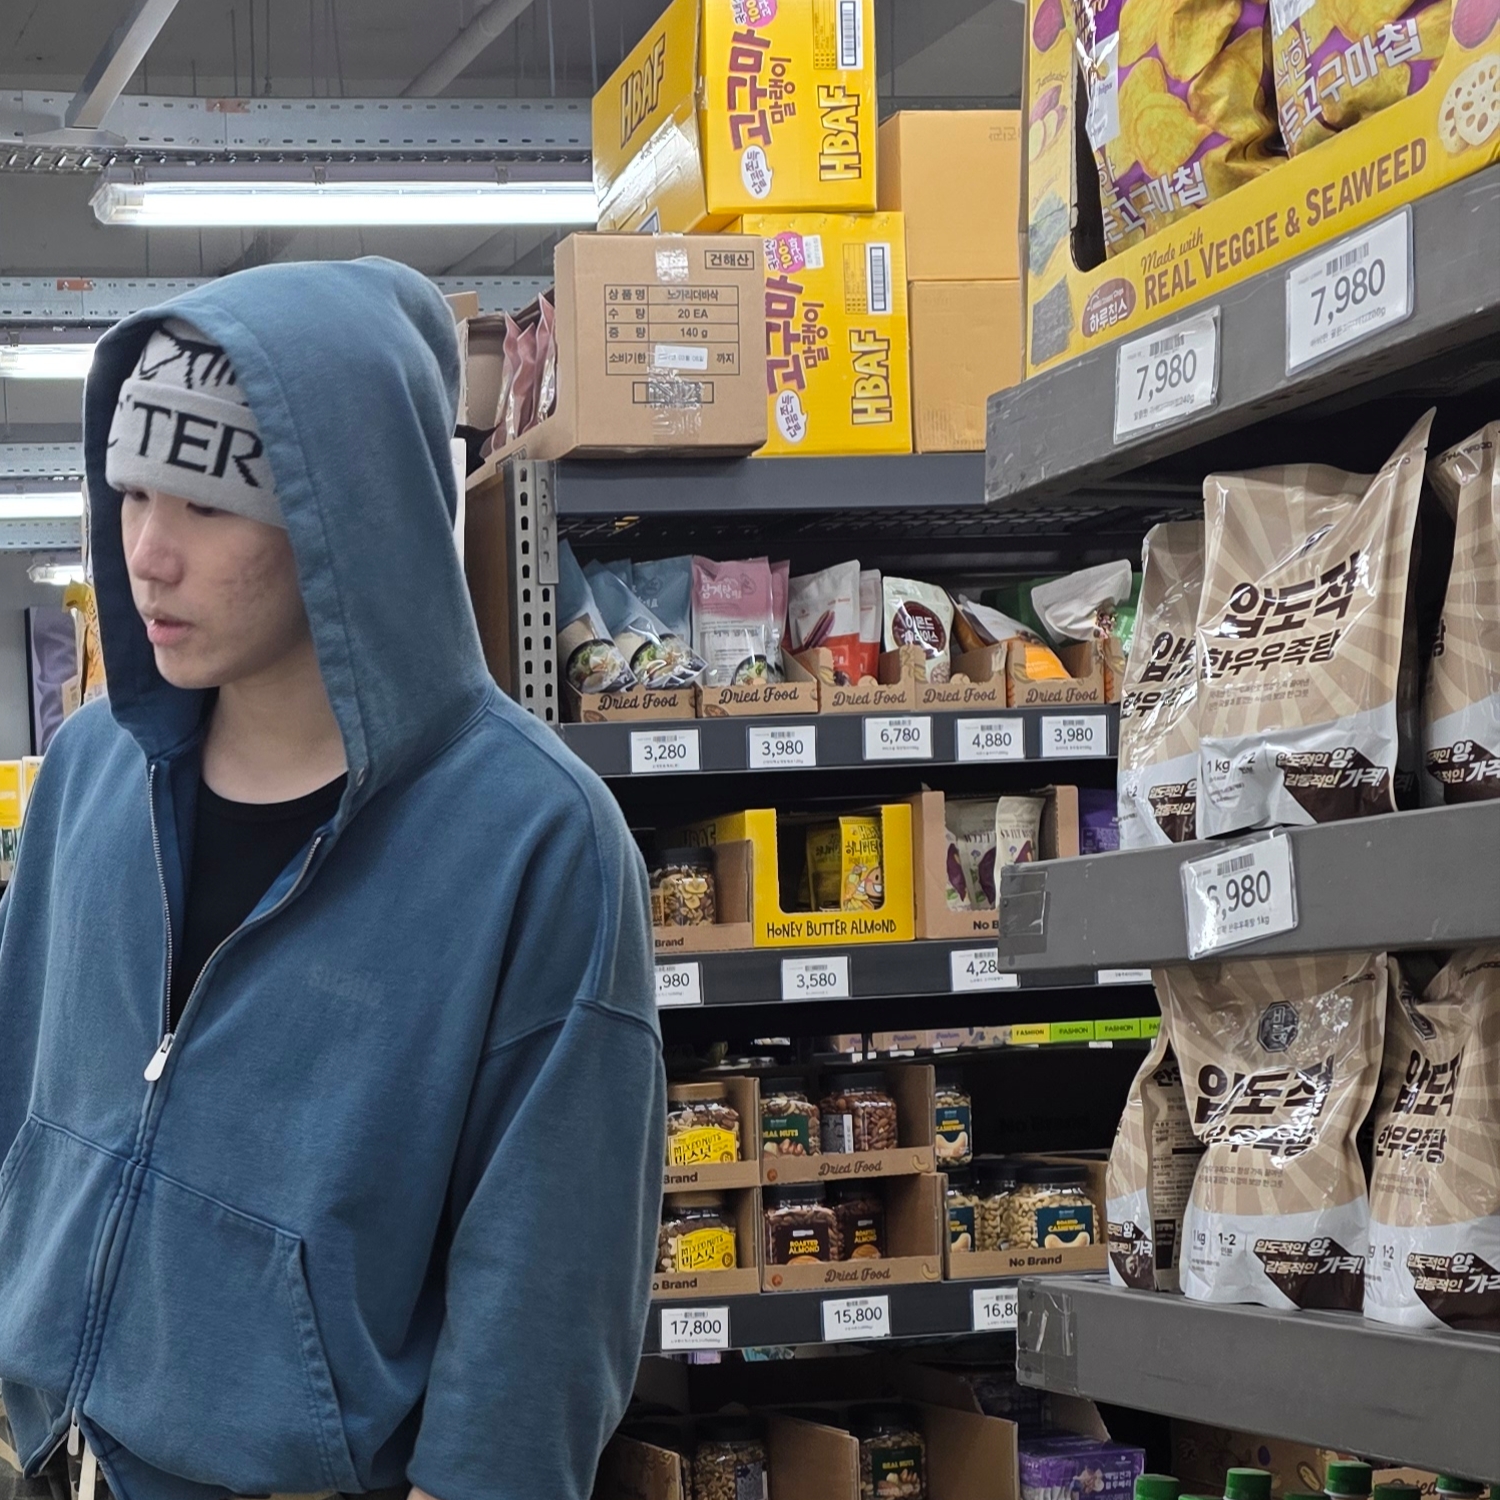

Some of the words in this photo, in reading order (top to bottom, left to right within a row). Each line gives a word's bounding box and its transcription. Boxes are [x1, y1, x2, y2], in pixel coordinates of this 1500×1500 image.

[620, 32, 666, 150] HBAF
[727, 28, 772, 150] 고구마
[768, 56, 796, 125] 말랭이
[817, 84, 862, 182] HBAF
[745, 150, 770, 196] 달콤쫀득
[1144, 259, 1197, 310] REAL
[1199, 212, 1280, 279] VEGGIE
[1285, 206, 1301, 238] &
[1305, 138, 1427, 227] SEAWEED
[710, 253, 750, 267] 건해산
[1141, 247, 1176, 276] Made
[1178, 226, 1204, 258] with
[1311, 258, 1386, 326] 7,980
[608, 308, 619, 319] 수
[635, 307, 646, 319] 량
[678, 308, 691, 319] 20
[693, 308, 709, 319] EA
[1088, 301, 1129, 333] 하루칩스
[680, 328, 699, 338] 140
[700, 329, 709, 339] g
[765, 274, 805, 394] 고구마
[801, 302, 830, 369] 말랭이
[609, 351, 647, 364] 소비기한
[716, 352, 735, 364] 까지
[849, 329, 893, 425] HBAF
[1136, 349, 1197, 402] 7,980
[779, 395, 801, 438] 달콤쫀득
[108, 396, 262, 488] TER
[1200, 629, 1344, 680] 한우우족탕
[599, 693, 642, 711] Dried
[643, 692, 678, 710] Food
[719, 687, 762, 706] Dried
[763, 686, 800, 704] Food
[832, 691, 874, 708] Dried
[875, 690, 908, 706] Food
[922, 687, 963, 705] Dried
[964, 686, 997, 703] Food
[1025, 688, 1064, 705] Dried
[1066, 686, 1099, 703] Food
[879, 727, 921, 745] 6,780
[971, 731, 1013, 749] 4,880
[1053, 726, 1094, 745] 3,980
[643, 743, 687, 761] 3,280
[761, 739, 805, 758] 3,980
[1214, 759, 1231, 774] kg
[1329, 747, 1355, 770] 양,
[1339, 766, 1388, 788] 가격!
[767, 921, 801, 938] HONEY
[806, 920, 848, 937] BUTTER
[850, 919, 898, 935] ALMOND
[973, 920, 990, 931] No
[966, 959, 998, 976] 4,28
[796, 972, 837, 989] 3,580
[818, 1161, 853, 1177] Dried
[853, 1159, 883, 1174] Food
[1218, 1232, 1237, 1246] 1-2
[1256, 1239, 1307, 1256] 압도적인
[1307, 1237, 1330, 1258] 양,
[1009, 1257, 1025, 1268] No
[1027, 1254, 1063, 1266] Brand
[1265, 1258, 1318, 1276] 감동적인
[1320, 1255, 1363, 1276] 가격!
[1407, 1253, 1450, 1271] 압도적인
[1450, 1252, 1476, 1273] 양,
[662, 1278, 698, 1290] Brand
[824, 1269, 859, 1283] Dried
[860, 1267, 891, 1281] Food
[1414, 1276, 1464, 1293] 감동적인
[834, 1306, 883, 1324] 15,800
[670, 1318, 722, 1336] 17,800
